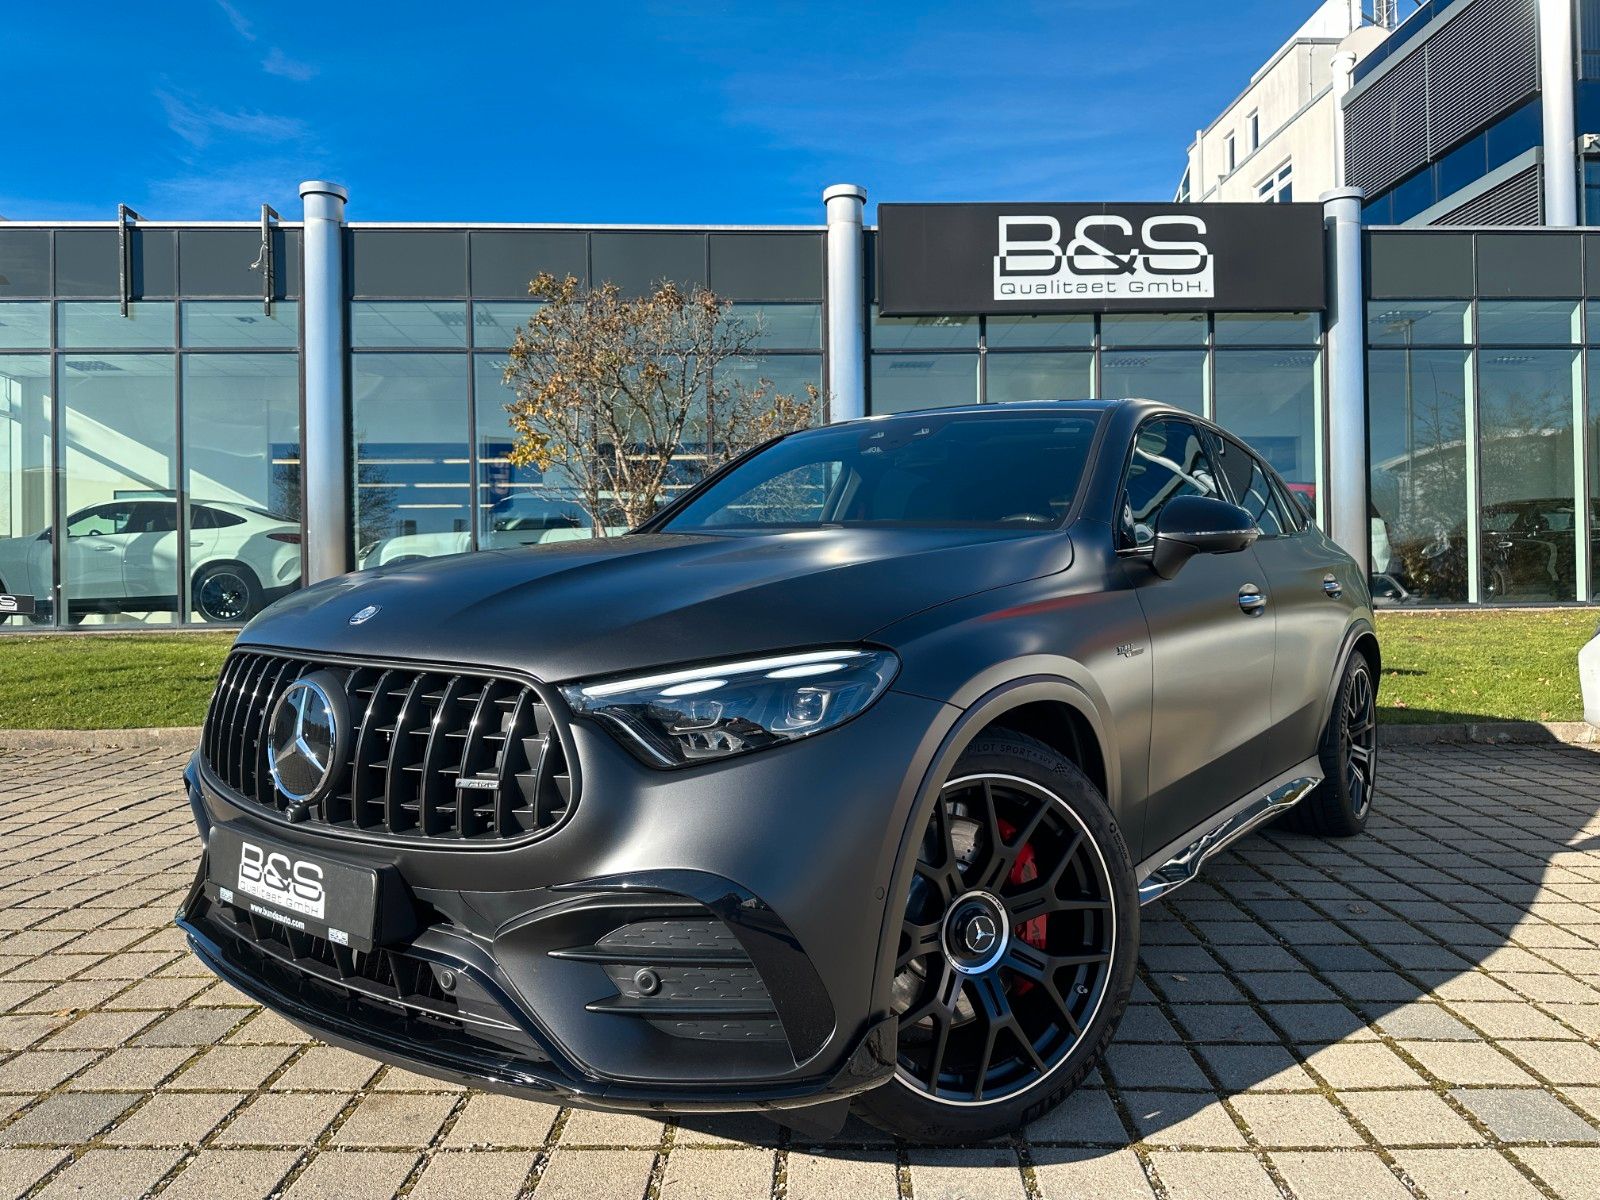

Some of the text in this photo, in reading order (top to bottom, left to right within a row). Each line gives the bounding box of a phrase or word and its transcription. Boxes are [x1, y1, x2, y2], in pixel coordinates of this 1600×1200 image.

[999, 215, 1208, 276] B&S
[1000, 278, 1208, 295] Qualitaet GmbH.
[1000, 744, 1033, 757] SPORT
[241, 841, 323, 902] B&S
